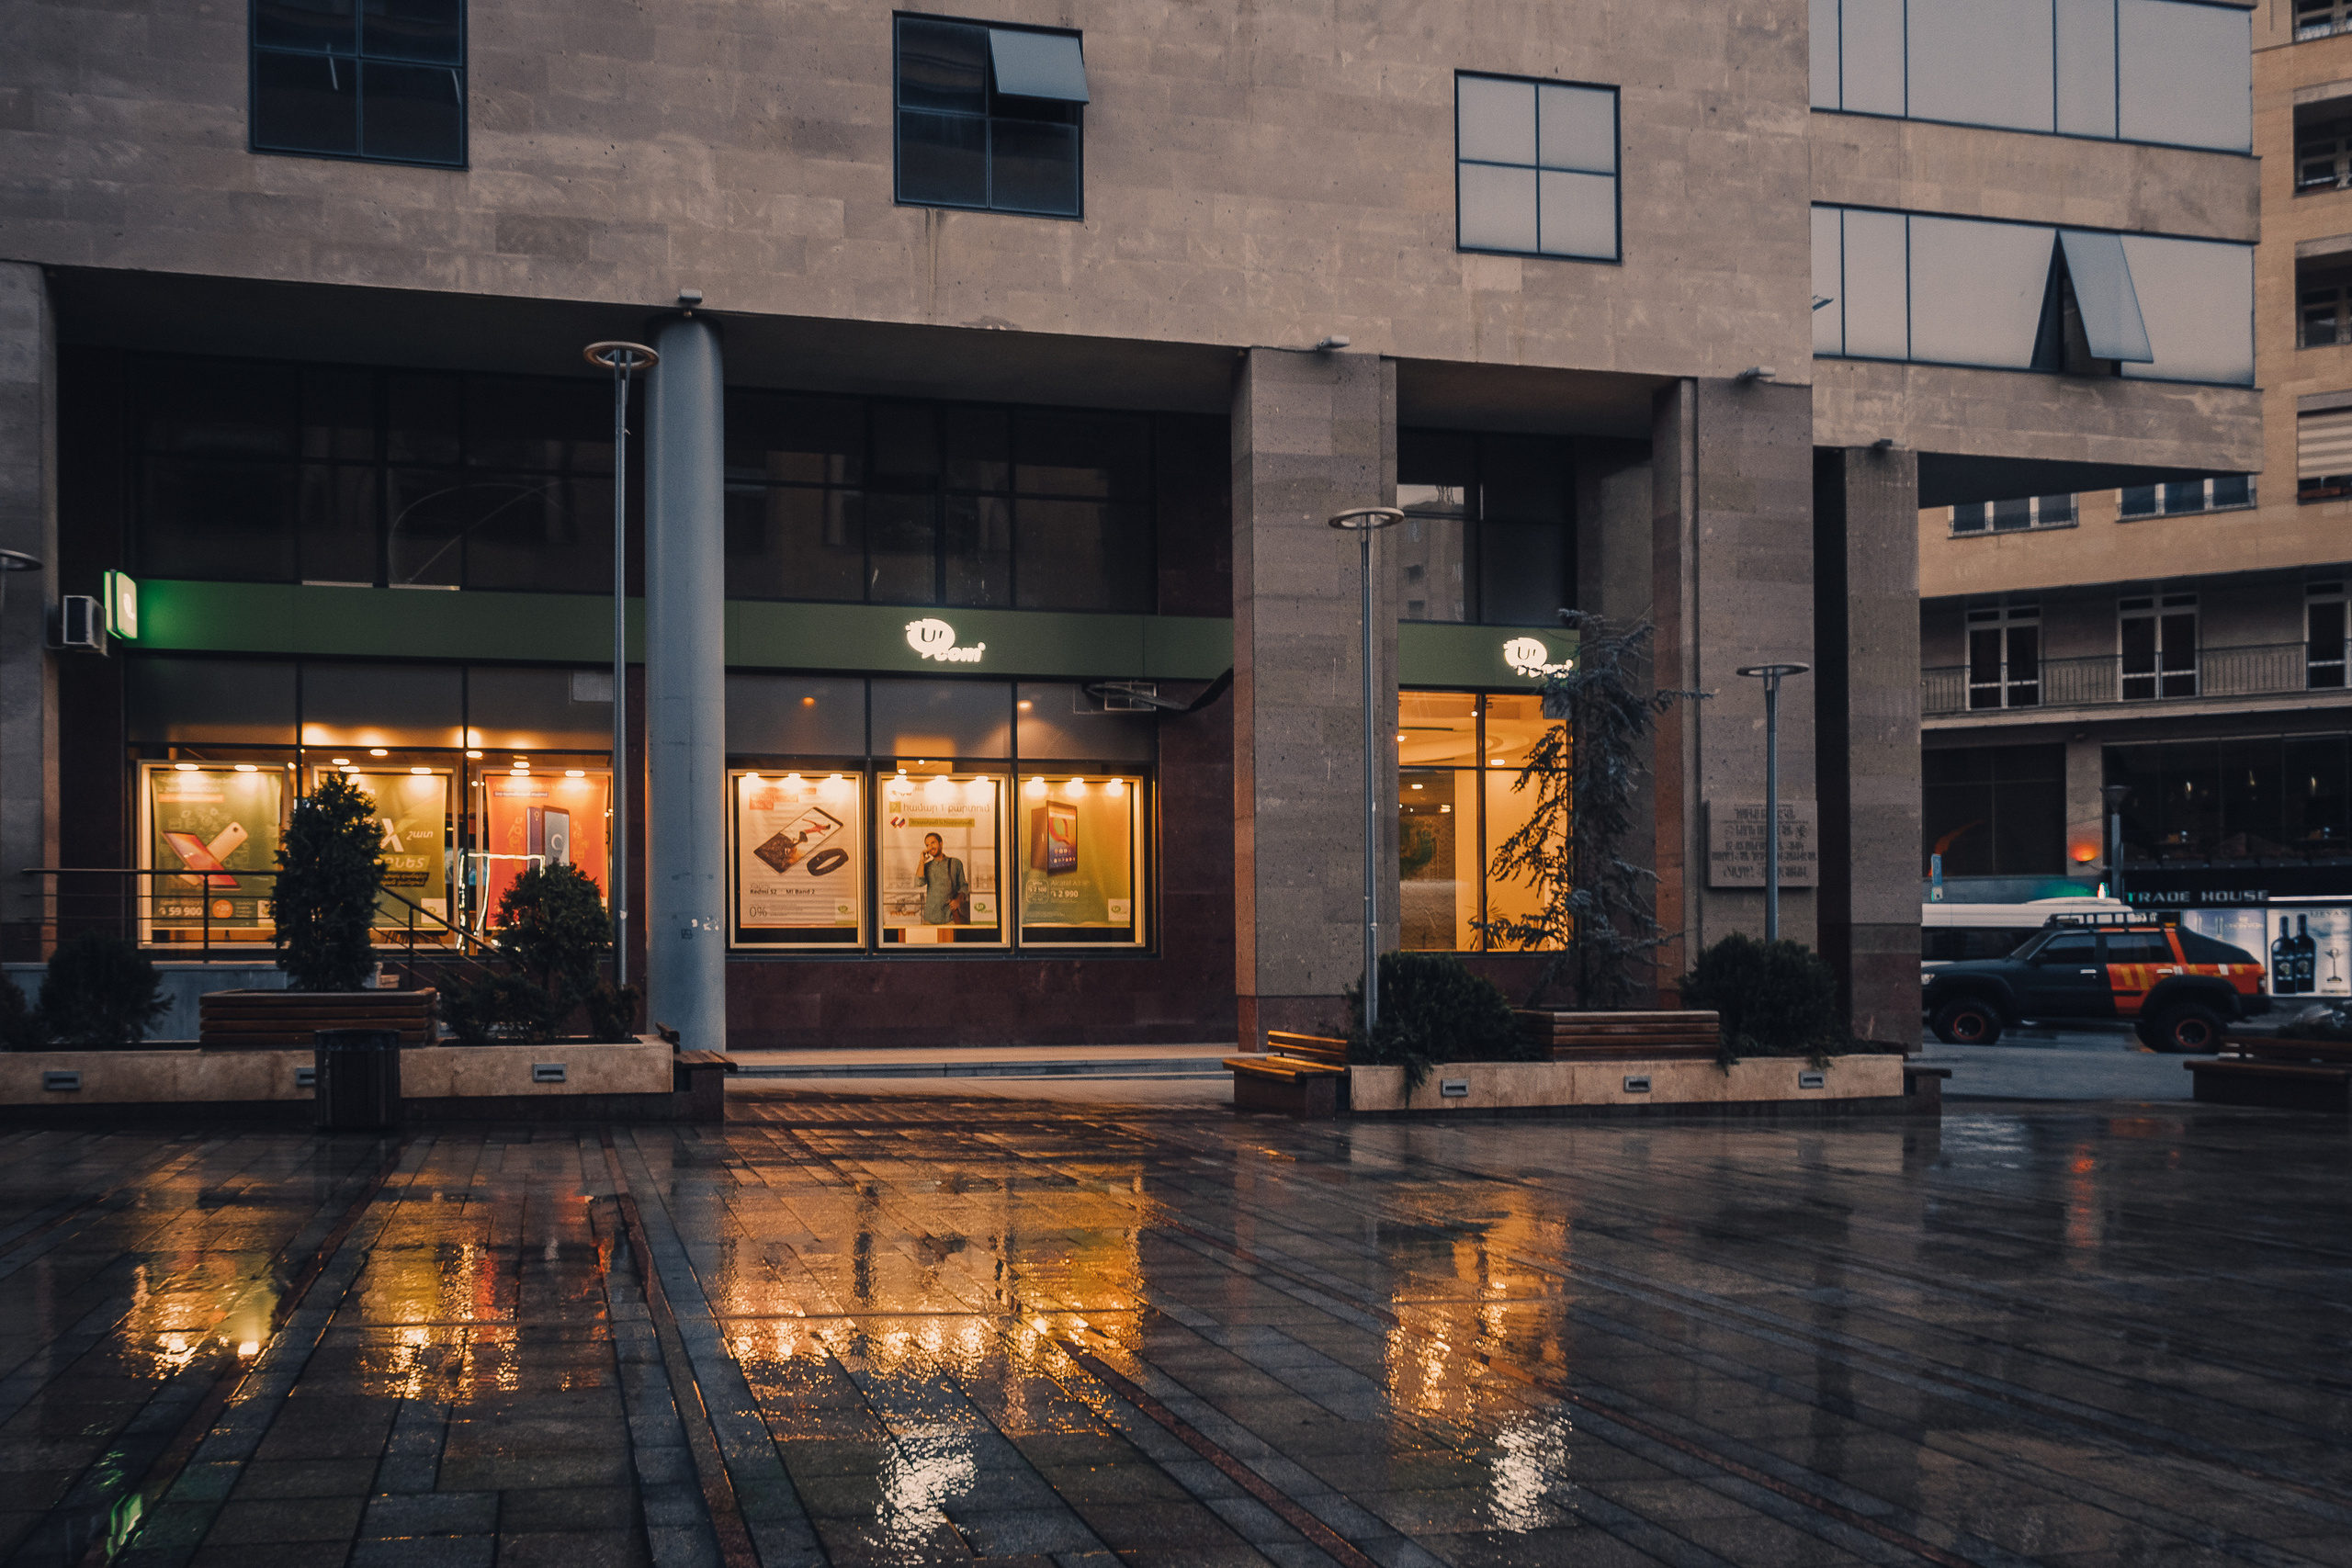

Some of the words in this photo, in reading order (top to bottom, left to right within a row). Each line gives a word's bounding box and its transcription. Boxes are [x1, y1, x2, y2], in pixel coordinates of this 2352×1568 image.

[406, 830, 433, 840] շատ
[2126, 891, 2190, 903] TRADE
[2201, 889, 2268, 902] HOUSE
[168, 907, 182, 916] 59
[749, 906, 768, 918] 0%
